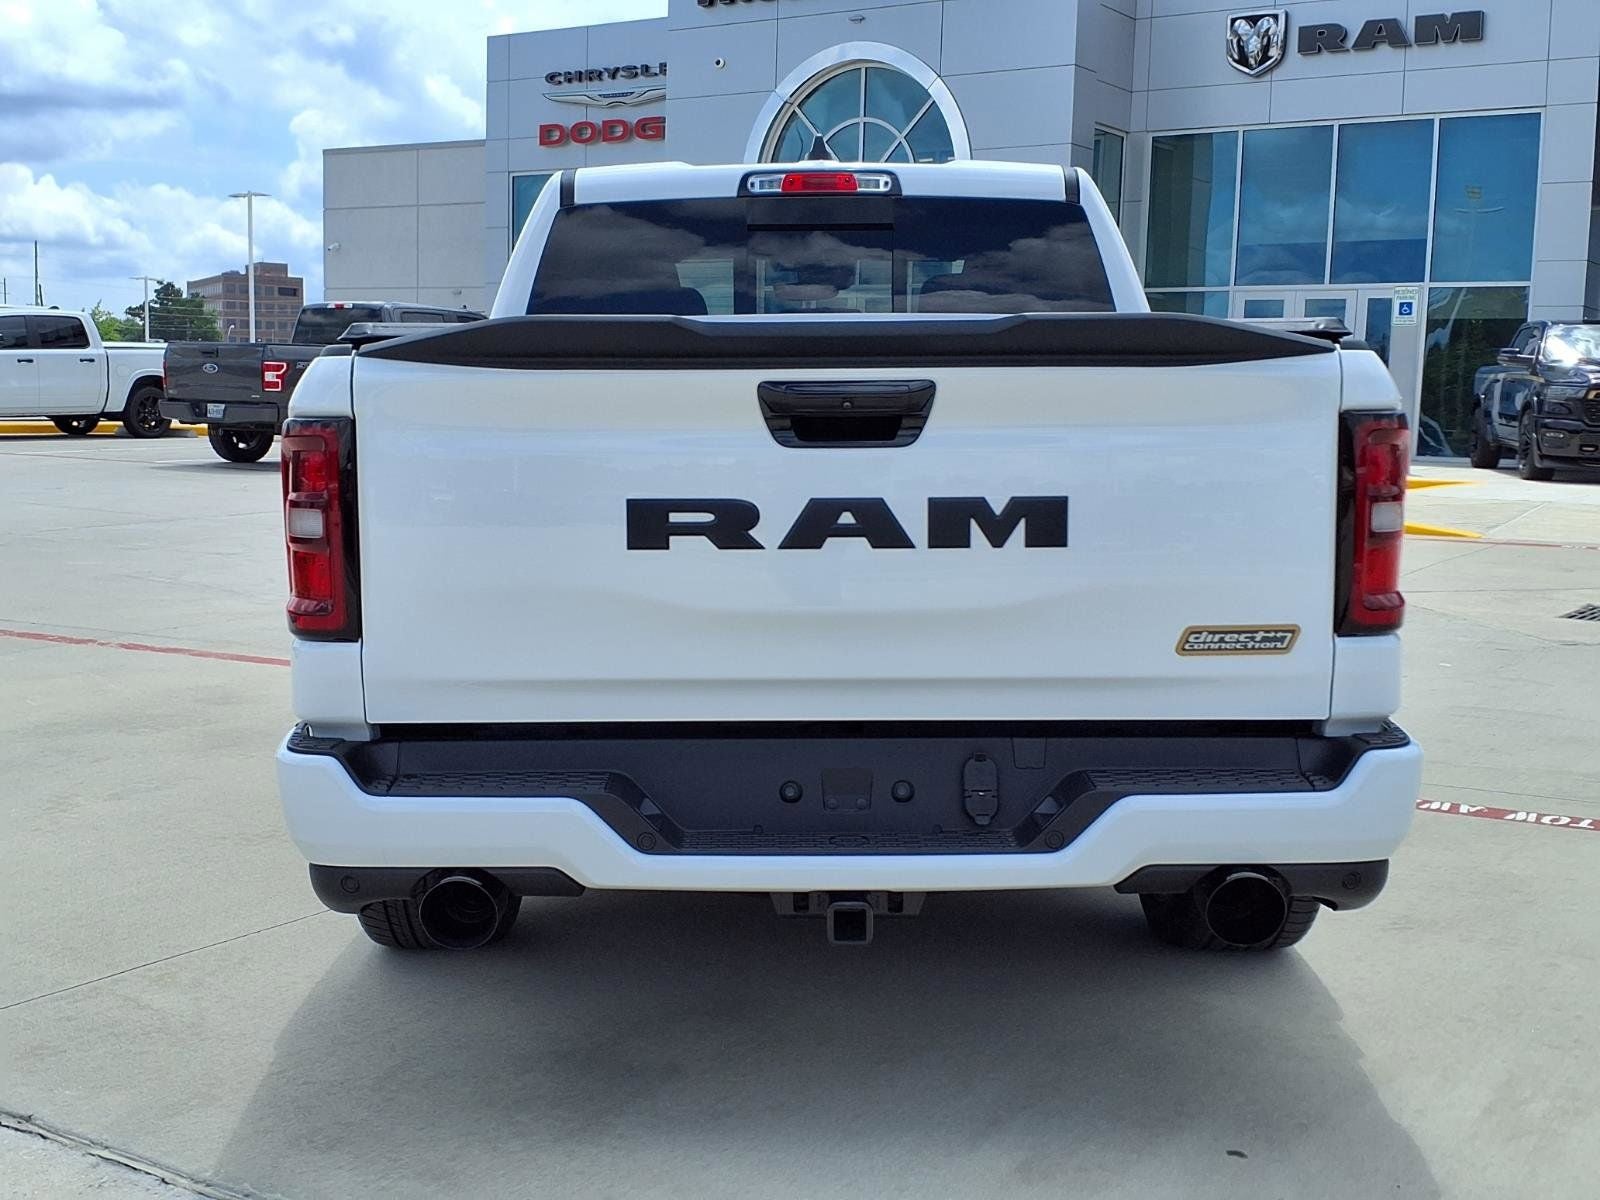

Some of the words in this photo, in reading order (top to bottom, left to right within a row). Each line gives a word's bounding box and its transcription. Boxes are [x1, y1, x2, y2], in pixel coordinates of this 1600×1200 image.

[1297, 9, 1486, 56] RAM
[626, 496, 1069, 550] RAM
[1183, 640, 1285, 650] connection
[1187, 630, 1268, 643] direct
